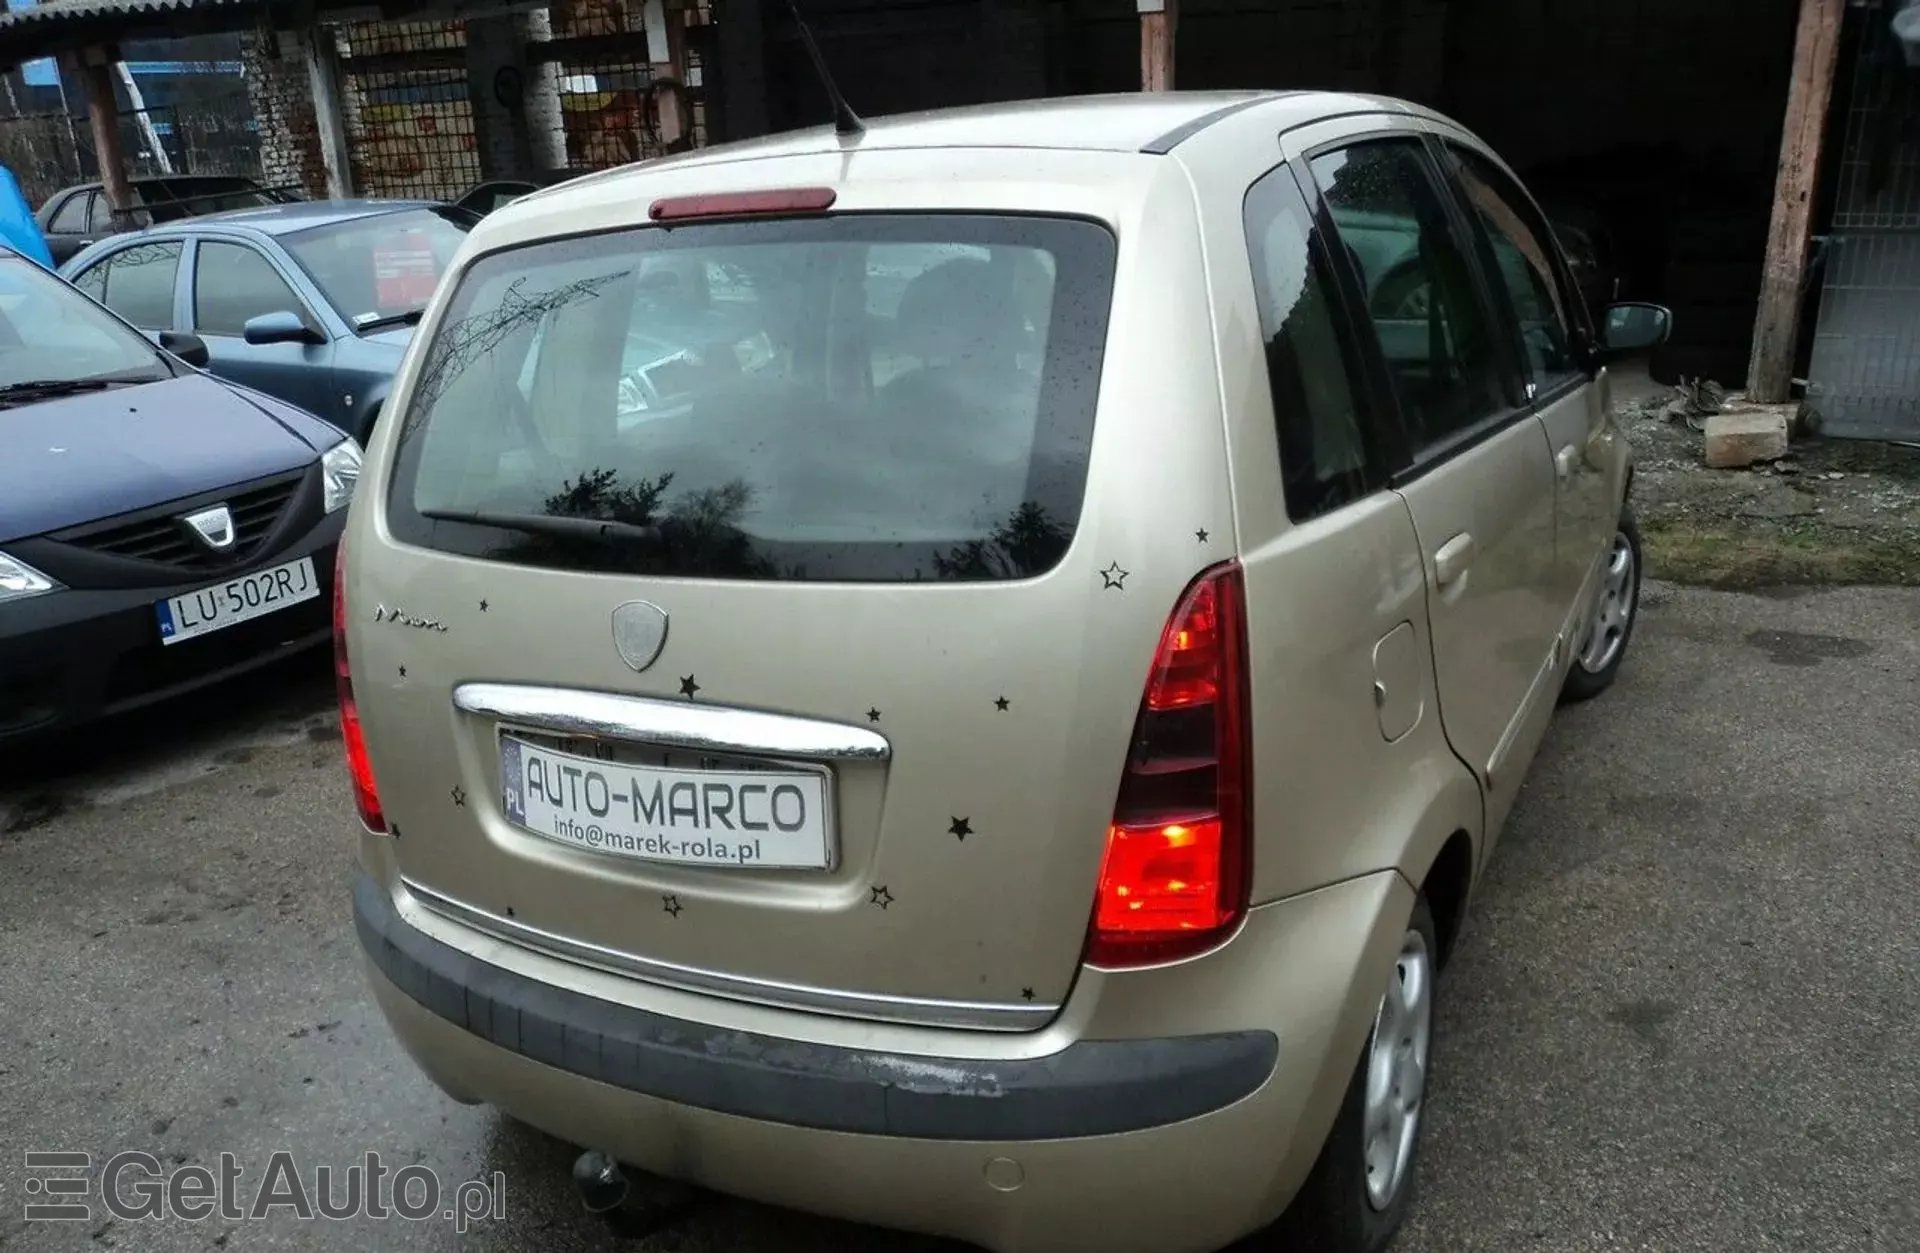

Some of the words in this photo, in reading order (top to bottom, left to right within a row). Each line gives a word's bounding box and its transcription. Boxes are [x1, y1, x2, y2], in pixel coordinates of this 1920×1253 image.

[177, 590, 218, 629] LU
[226, 562, 309, 613] 502RJ
[506, 787, 525, 816] PL
[527, 756, 806, 833] AUTO-MARCO
[554, 814, 761, 864] info@marek-rola.pl
